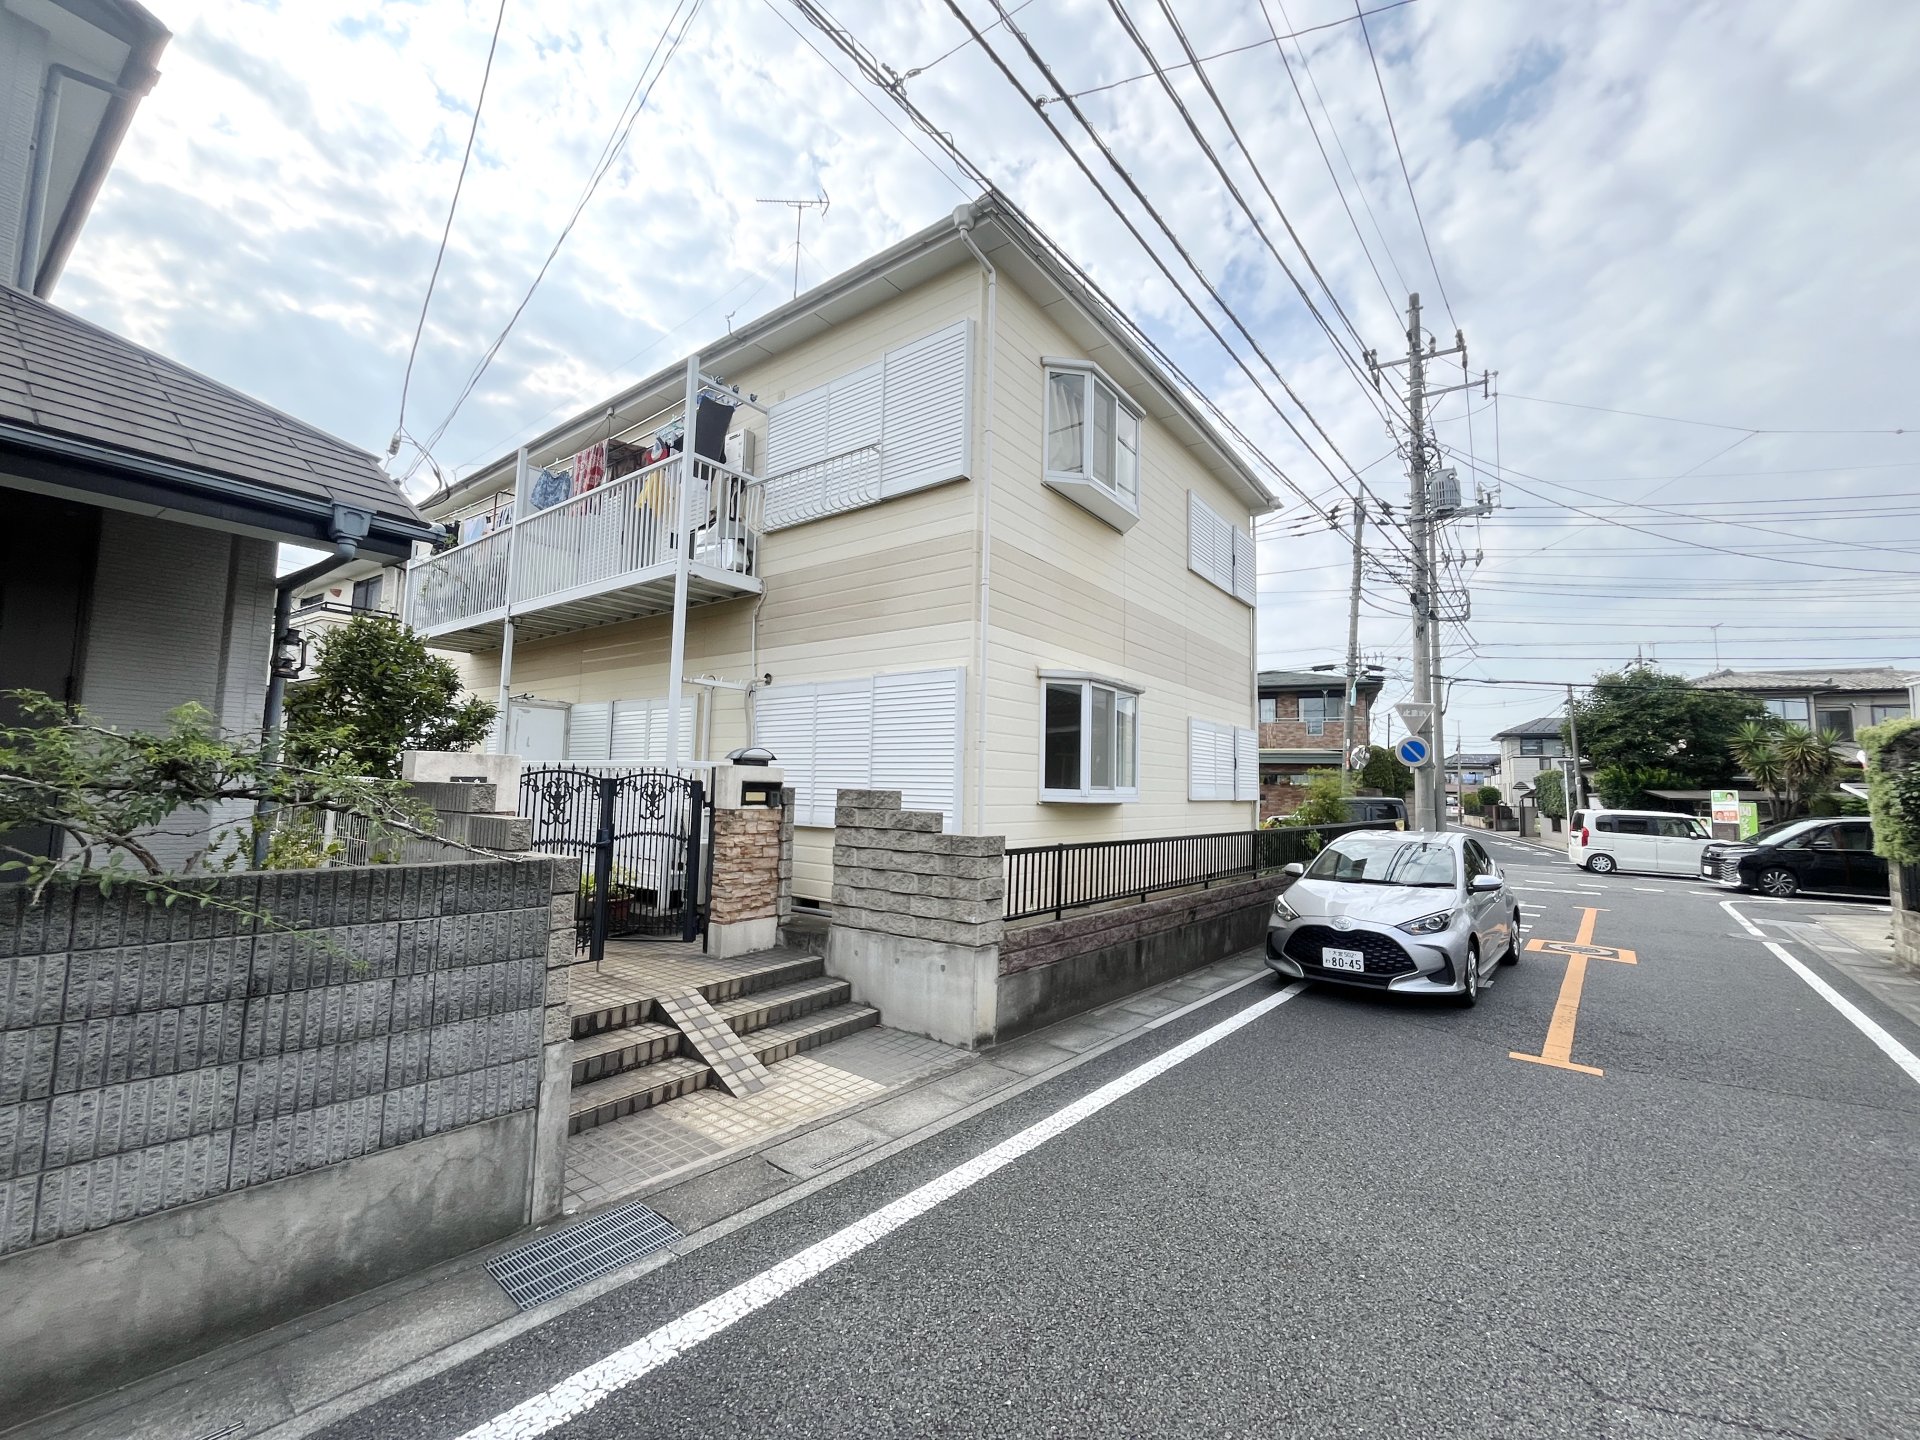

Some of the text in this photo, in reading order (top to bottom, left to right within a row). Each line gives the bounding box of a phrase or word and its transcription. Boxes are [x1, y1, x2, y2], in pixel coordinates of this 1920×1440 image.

[1402, 709, 1427, 717] 止まれ
[1331, 957, 1362, 970] 80-45
